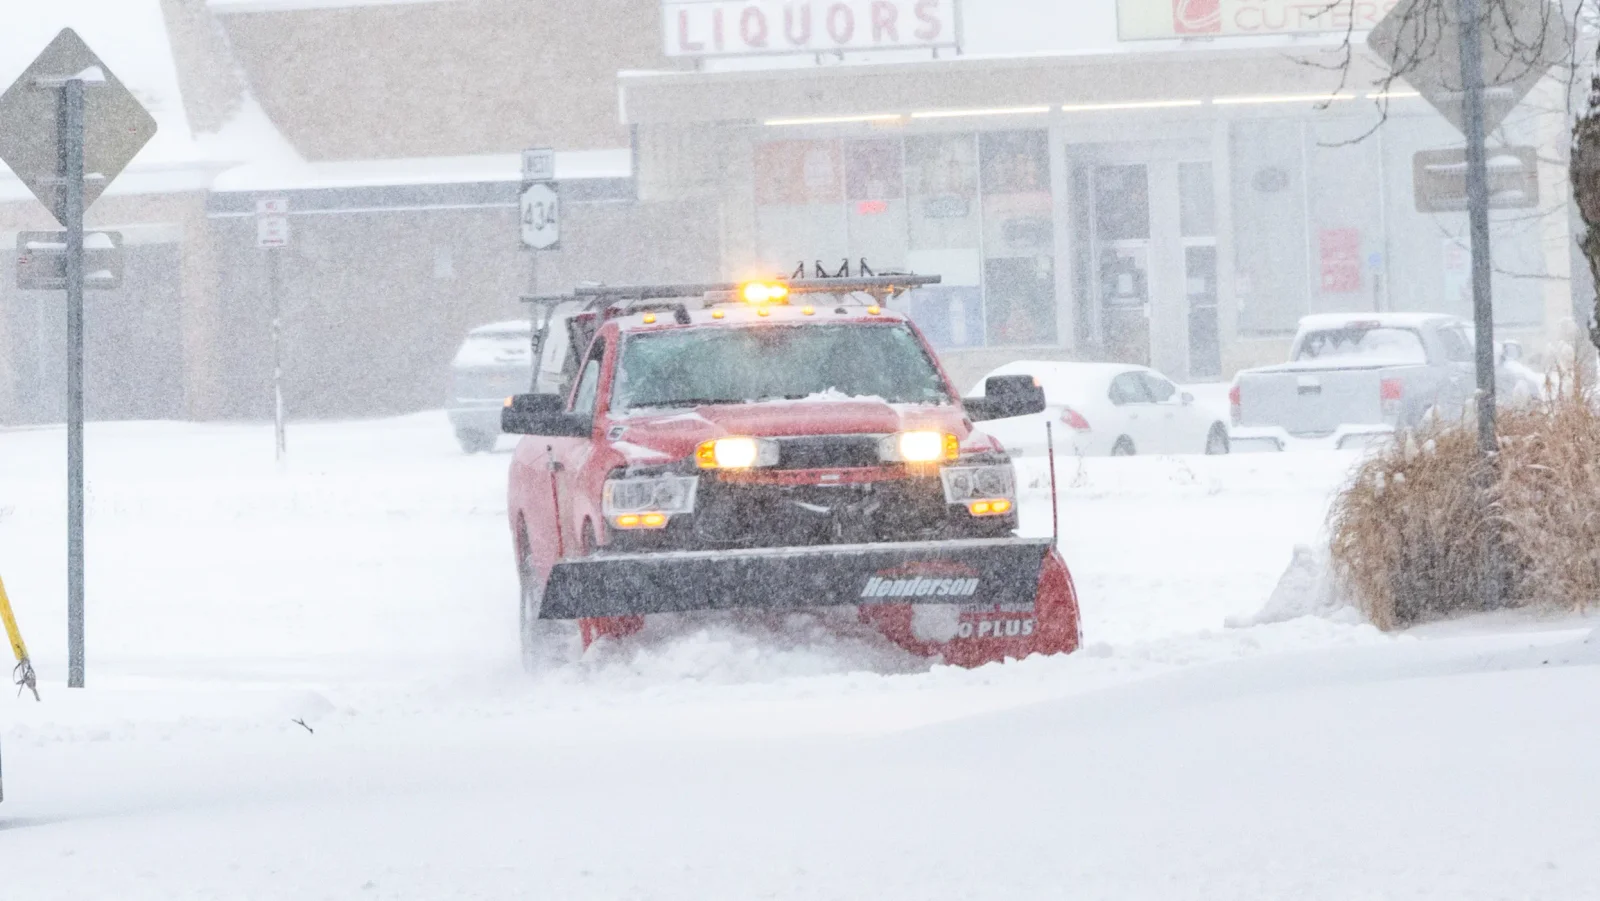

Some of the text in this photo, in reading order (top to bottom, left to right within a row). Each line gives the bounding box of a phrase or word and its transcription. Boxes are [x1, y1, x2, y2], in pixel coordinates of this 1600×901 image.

[678, 0, 942, 51] LIQUORS
[524, 200, 556, 231] 434
[860, 576, 980, 597] Henderson
[978, 618, 1035, 638] PLUS
